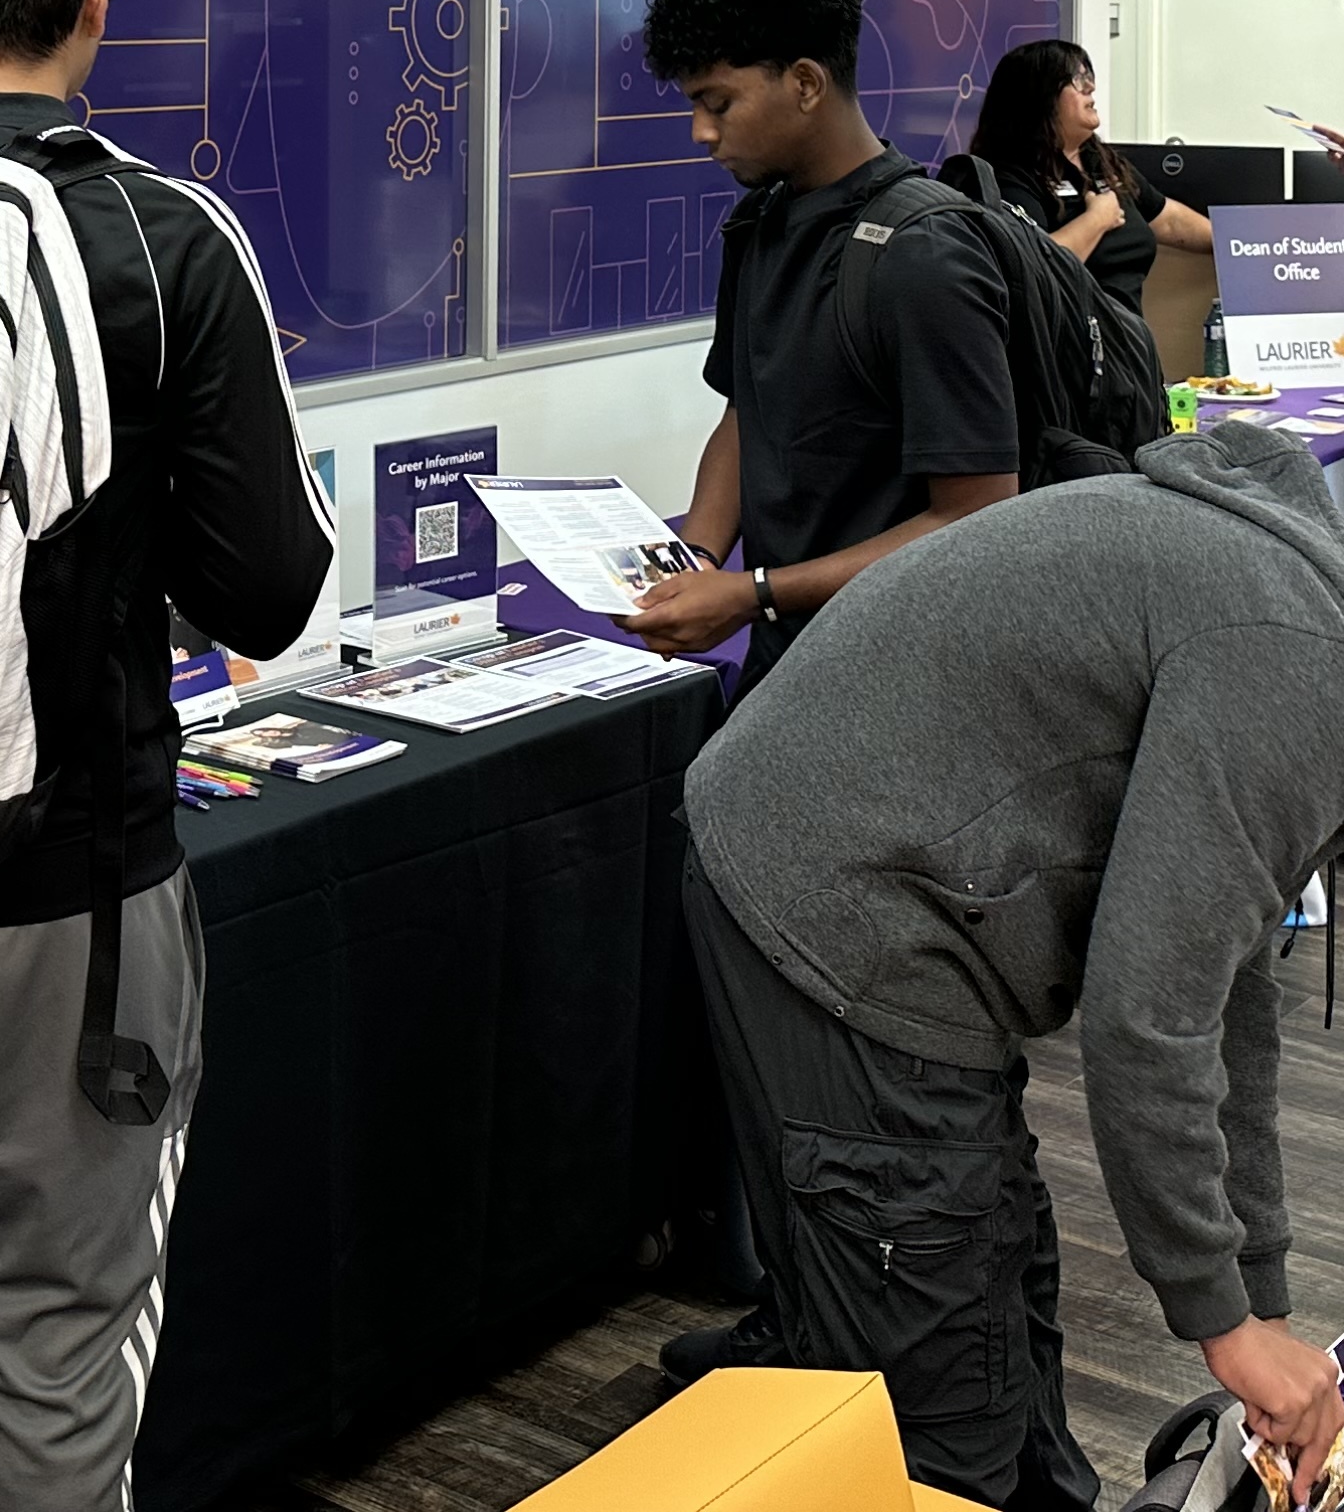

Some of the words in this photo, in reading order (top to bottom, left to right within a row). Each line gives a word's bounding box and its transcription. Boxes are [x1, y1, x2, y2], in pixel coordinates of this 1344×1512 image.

[1230, 239, 1270, 256] Dean
[1273, 237, 1290, 255] of
[1273, 262, 1321, 281] Office
[1256, 341, 1333, 361] LAURIER
[388, 461, 423, 475] Career
[425, 449, 485, 469] Information
[414, 475, 428, 490] by
[429, 470, 460, 486] Major
[413, 617, 450, 634] LAURIER
